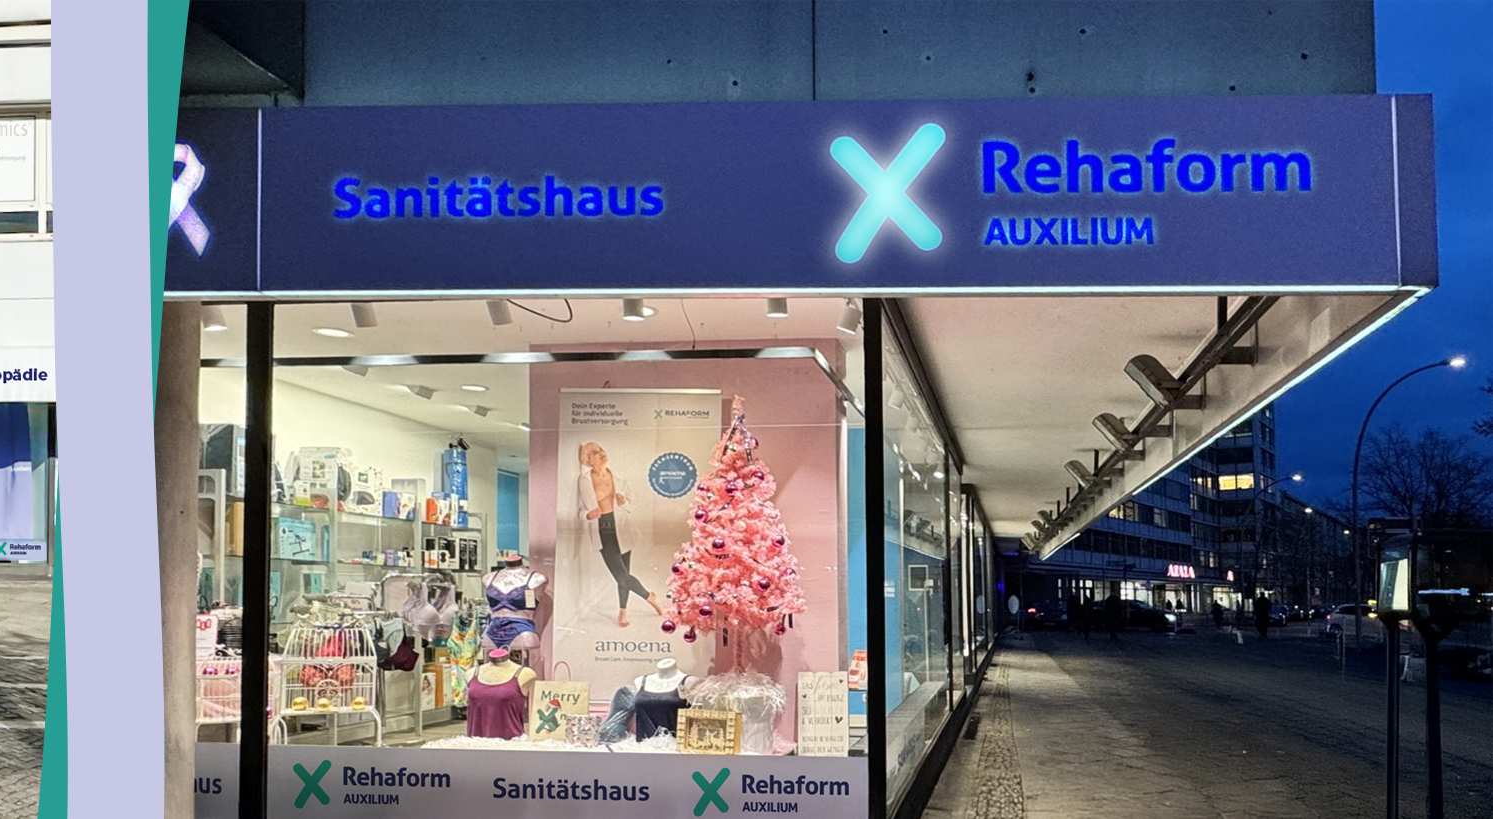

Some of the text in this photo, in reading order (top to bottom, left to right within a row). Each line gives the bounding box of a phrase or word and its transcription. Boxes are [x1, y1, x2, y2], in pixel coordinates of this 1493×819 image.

[980, 137, 1314, 196] Rehaform
[331, 172, 665, 221] Sanitätshaus
[984, 216, 1155, 247] AUXILIUM
[10, 543, 41, 551] Rehaform
[595, 640, 672, 653] amoena
[541, 690, 580, 705] Merry
[342, 767, 451, 788] Rehaform
[741, 774, 850, 796] Rehaform
[343, 794, 400, 805] AUXILIUM
[492, 777, 650, 801] Sanitätshaus
[742, 801, 798, 813] AUXILIUM
